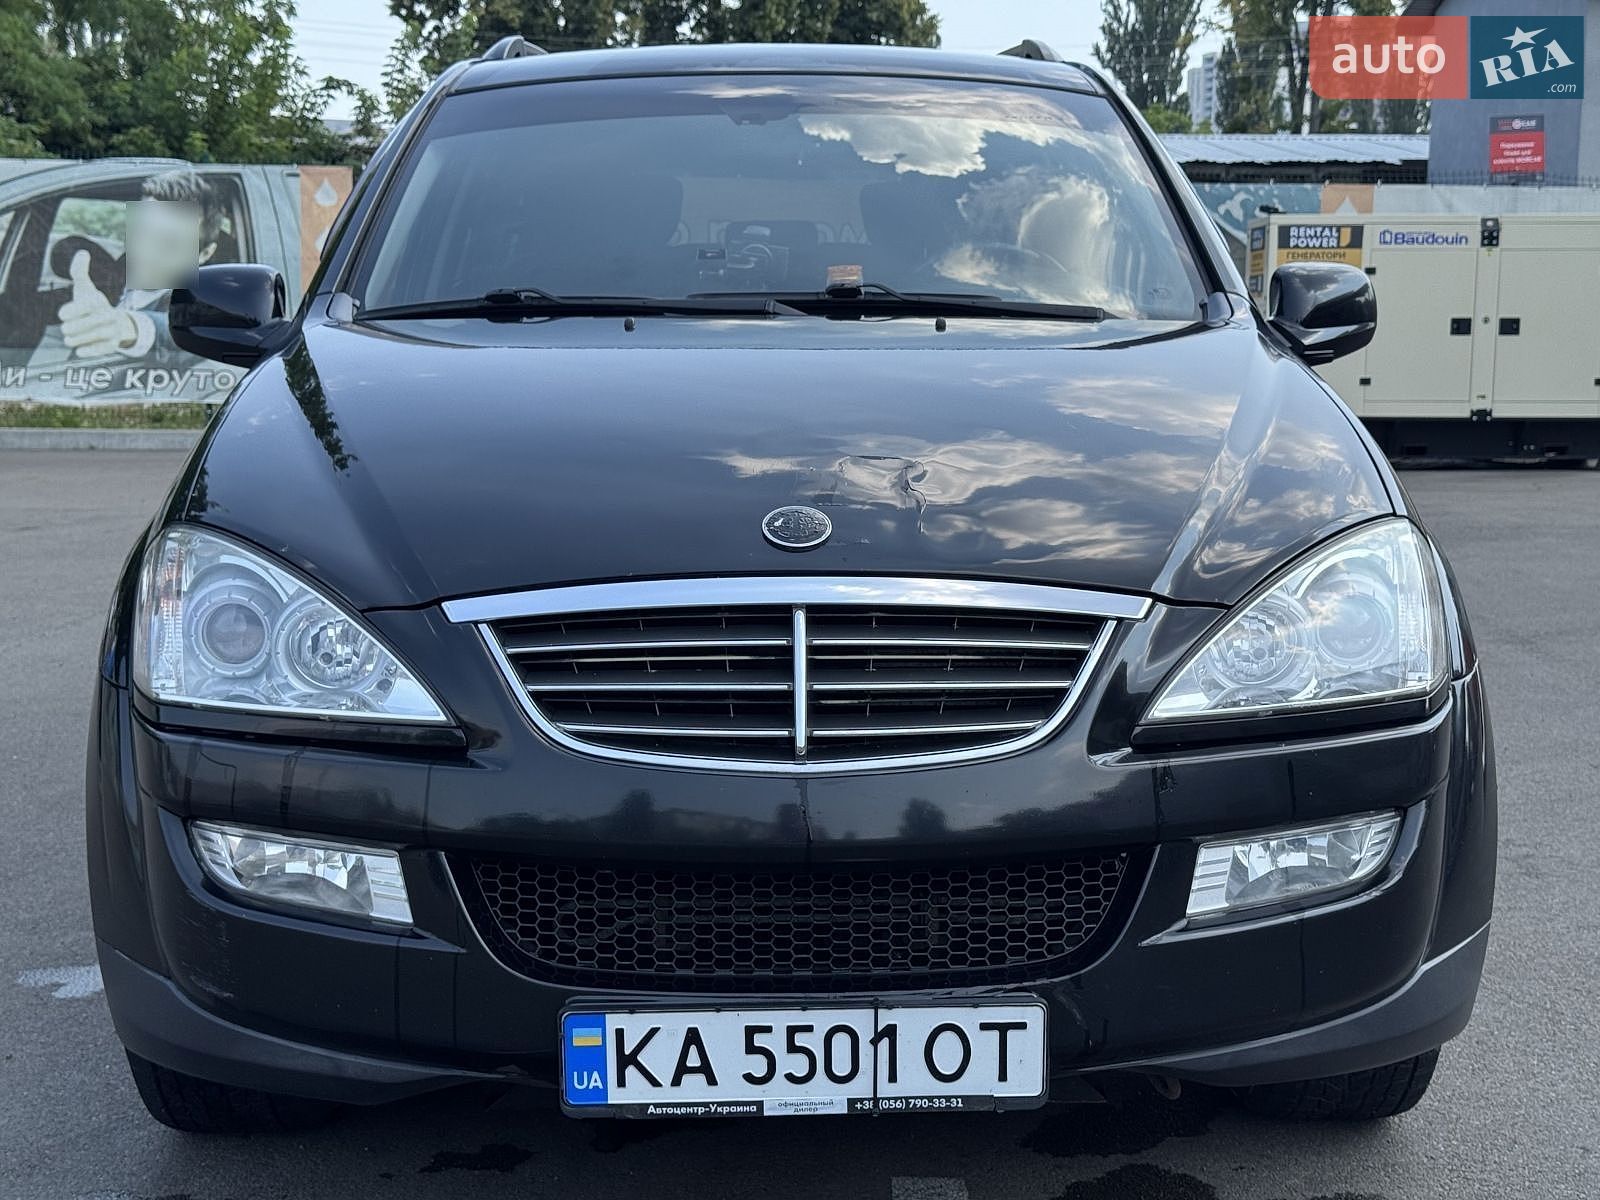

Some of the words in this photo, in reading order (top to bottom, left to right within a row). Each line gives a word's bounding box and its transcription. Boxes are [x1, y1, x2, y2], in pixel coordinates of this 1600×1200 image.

[1289, 226, 1339, 237] RENTAL
[1289, 238, 1338, 248] POWER
[1394, 231, 1469, 246] Baudouin
[1286, 251, 1346, 260] ГЕНЕРАТОРИ
[0, 366, 25, 387] и
[65, 367, 112, 391] це
[125, 368, 236, 396] круто
[614, 1025, 719, 1088] KA
[741, 1022, 898, 1086] 5501
[923, 1021, 1028, 1083] OT
[573, 1071, 603, 1090] UA
[646, 1103, 757, 1116] Автоцентр-Украина
[777, 1099, 834, 1108] официальный
[793, 1106, 819, 1114] дилер
[878, 1099, 906, 1111] (056)
[908, 1097, 964, 1108] 790-33-31
